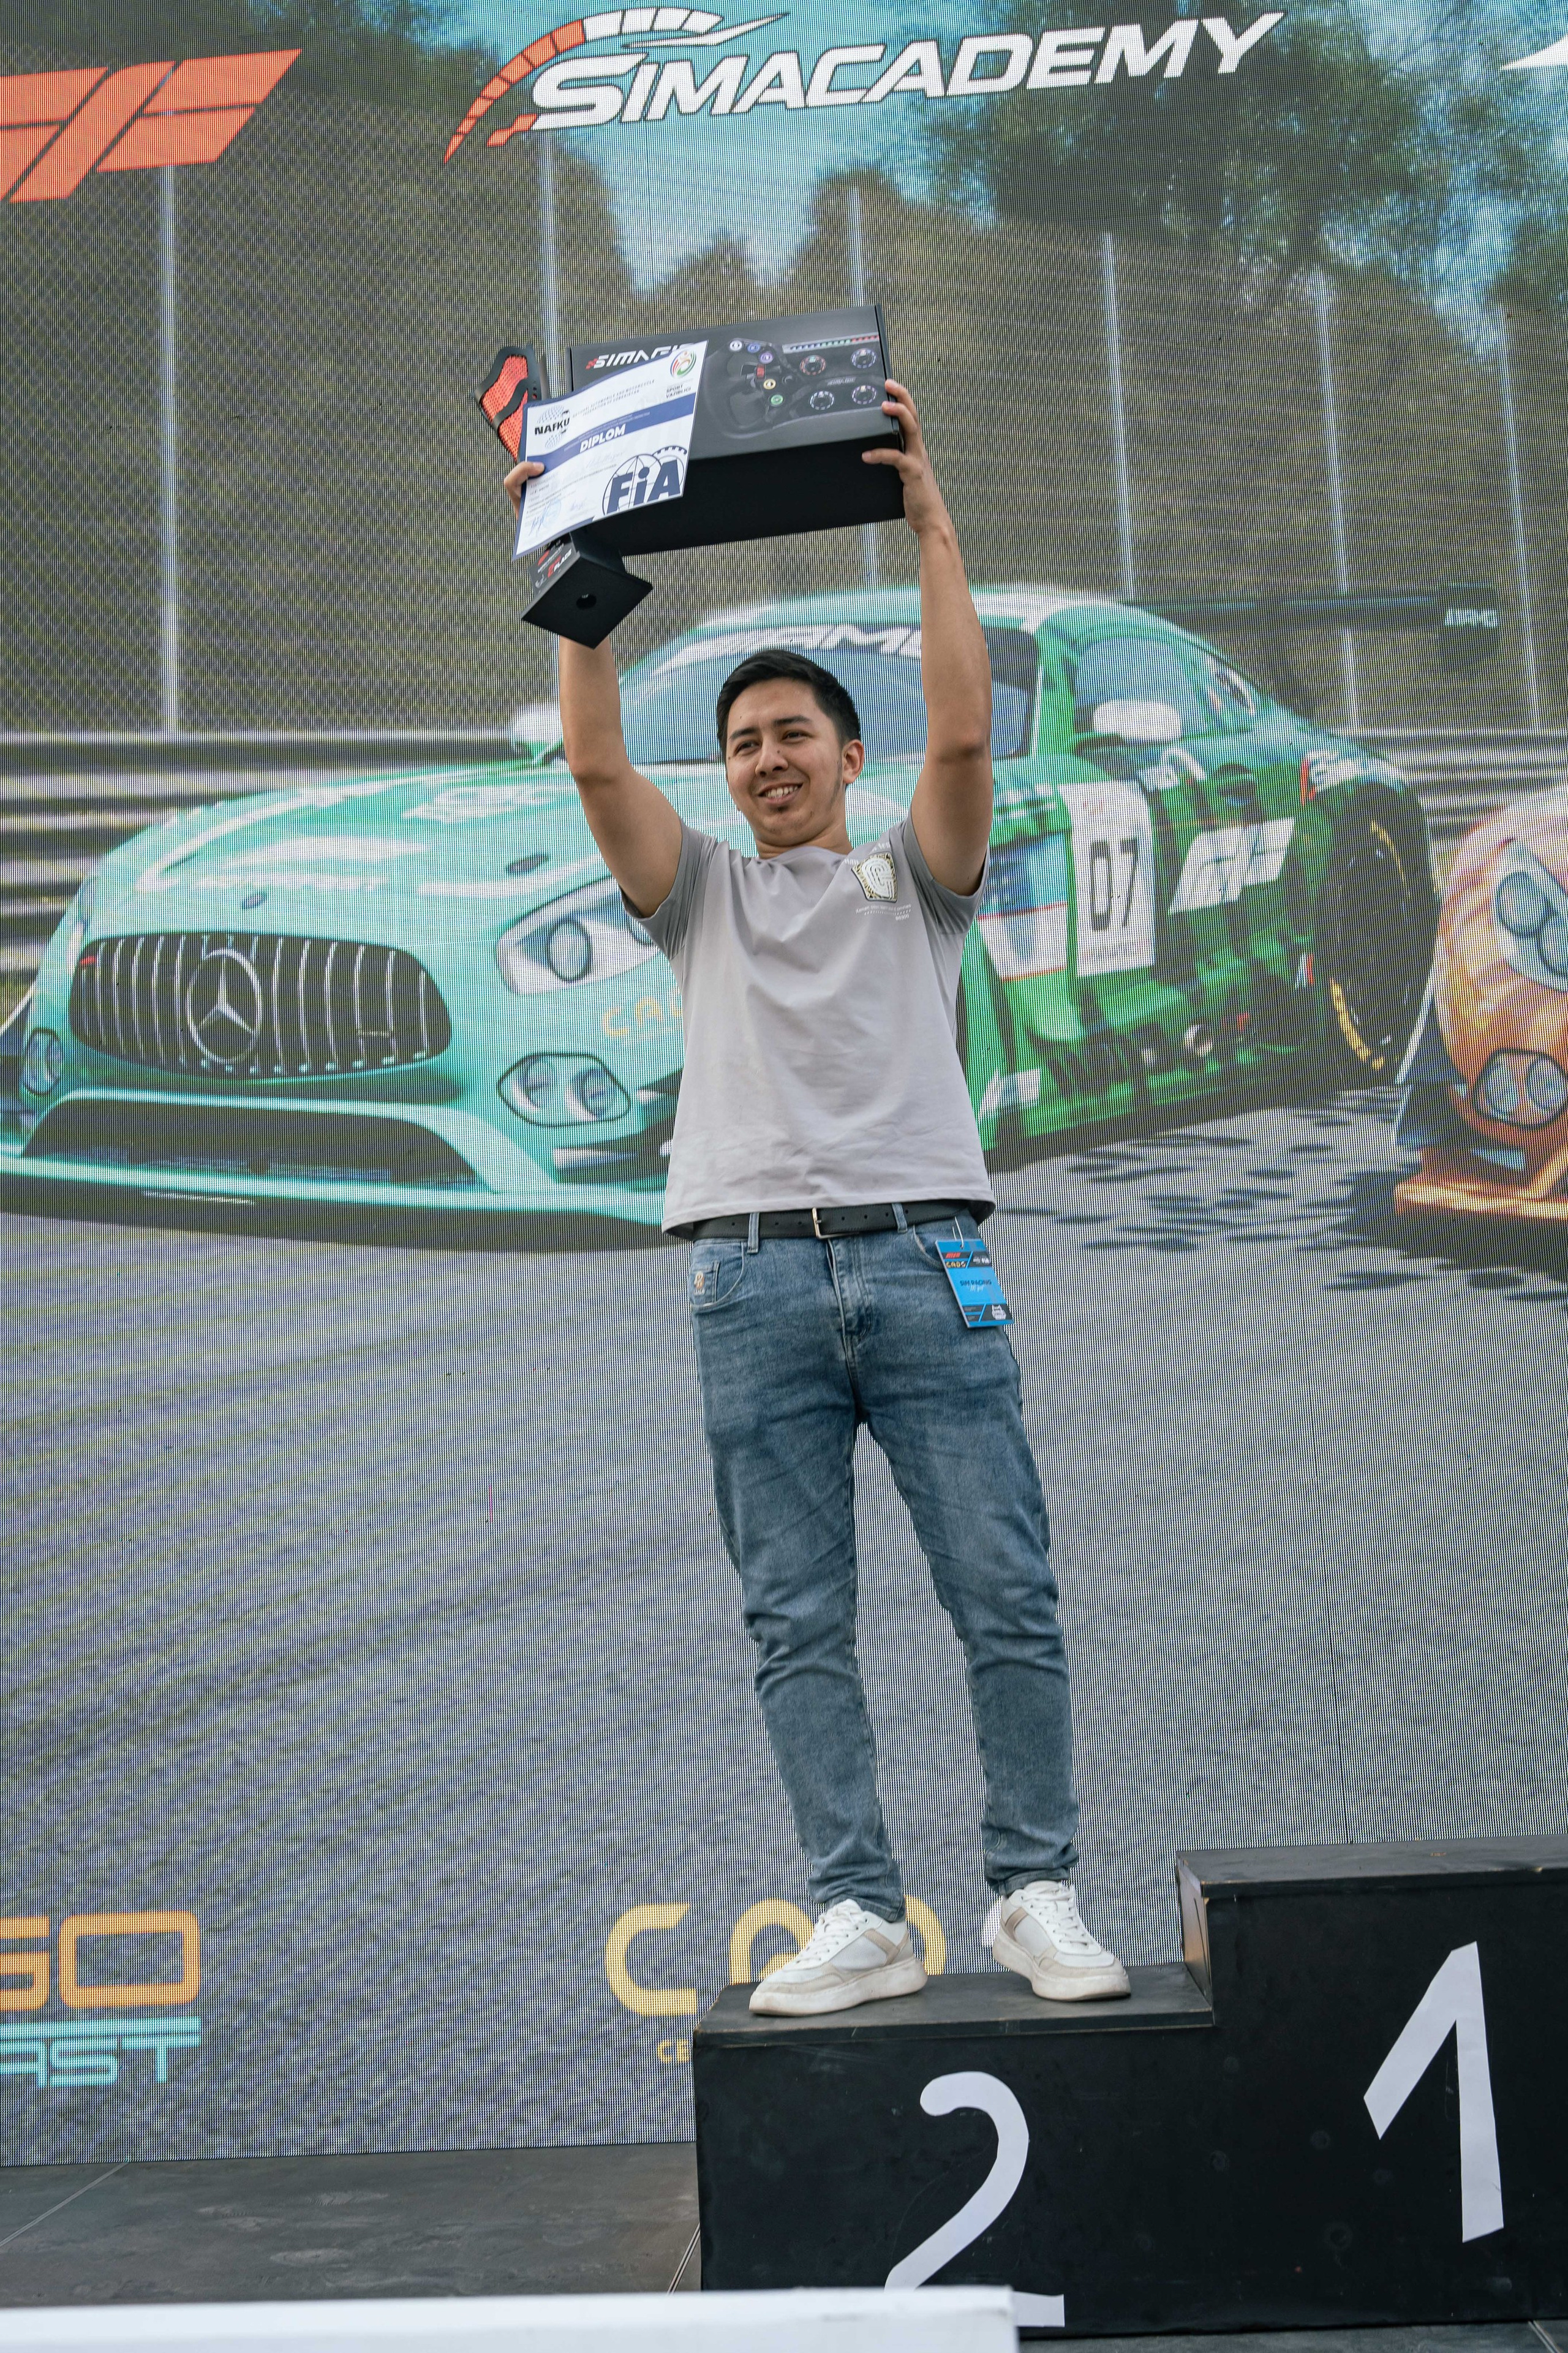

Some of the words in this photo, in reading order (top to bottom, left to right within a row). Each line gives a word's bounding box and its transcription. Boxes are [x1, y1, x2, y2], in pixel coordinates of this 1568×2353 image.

[532, 12, 1284, 130] SIMACADEMY
[666, 383, 683, 393] SPORT
[534, 418, 570, 436] NAFKU
[579, 424, 627, 453] DIPLOM
[553, 548, 572, 572] PLACE
[1090, 837, 1139, 932] 07
[1363, 1941, 1504, 2243] 1
[884, 2071, 1065, 2327] 2
